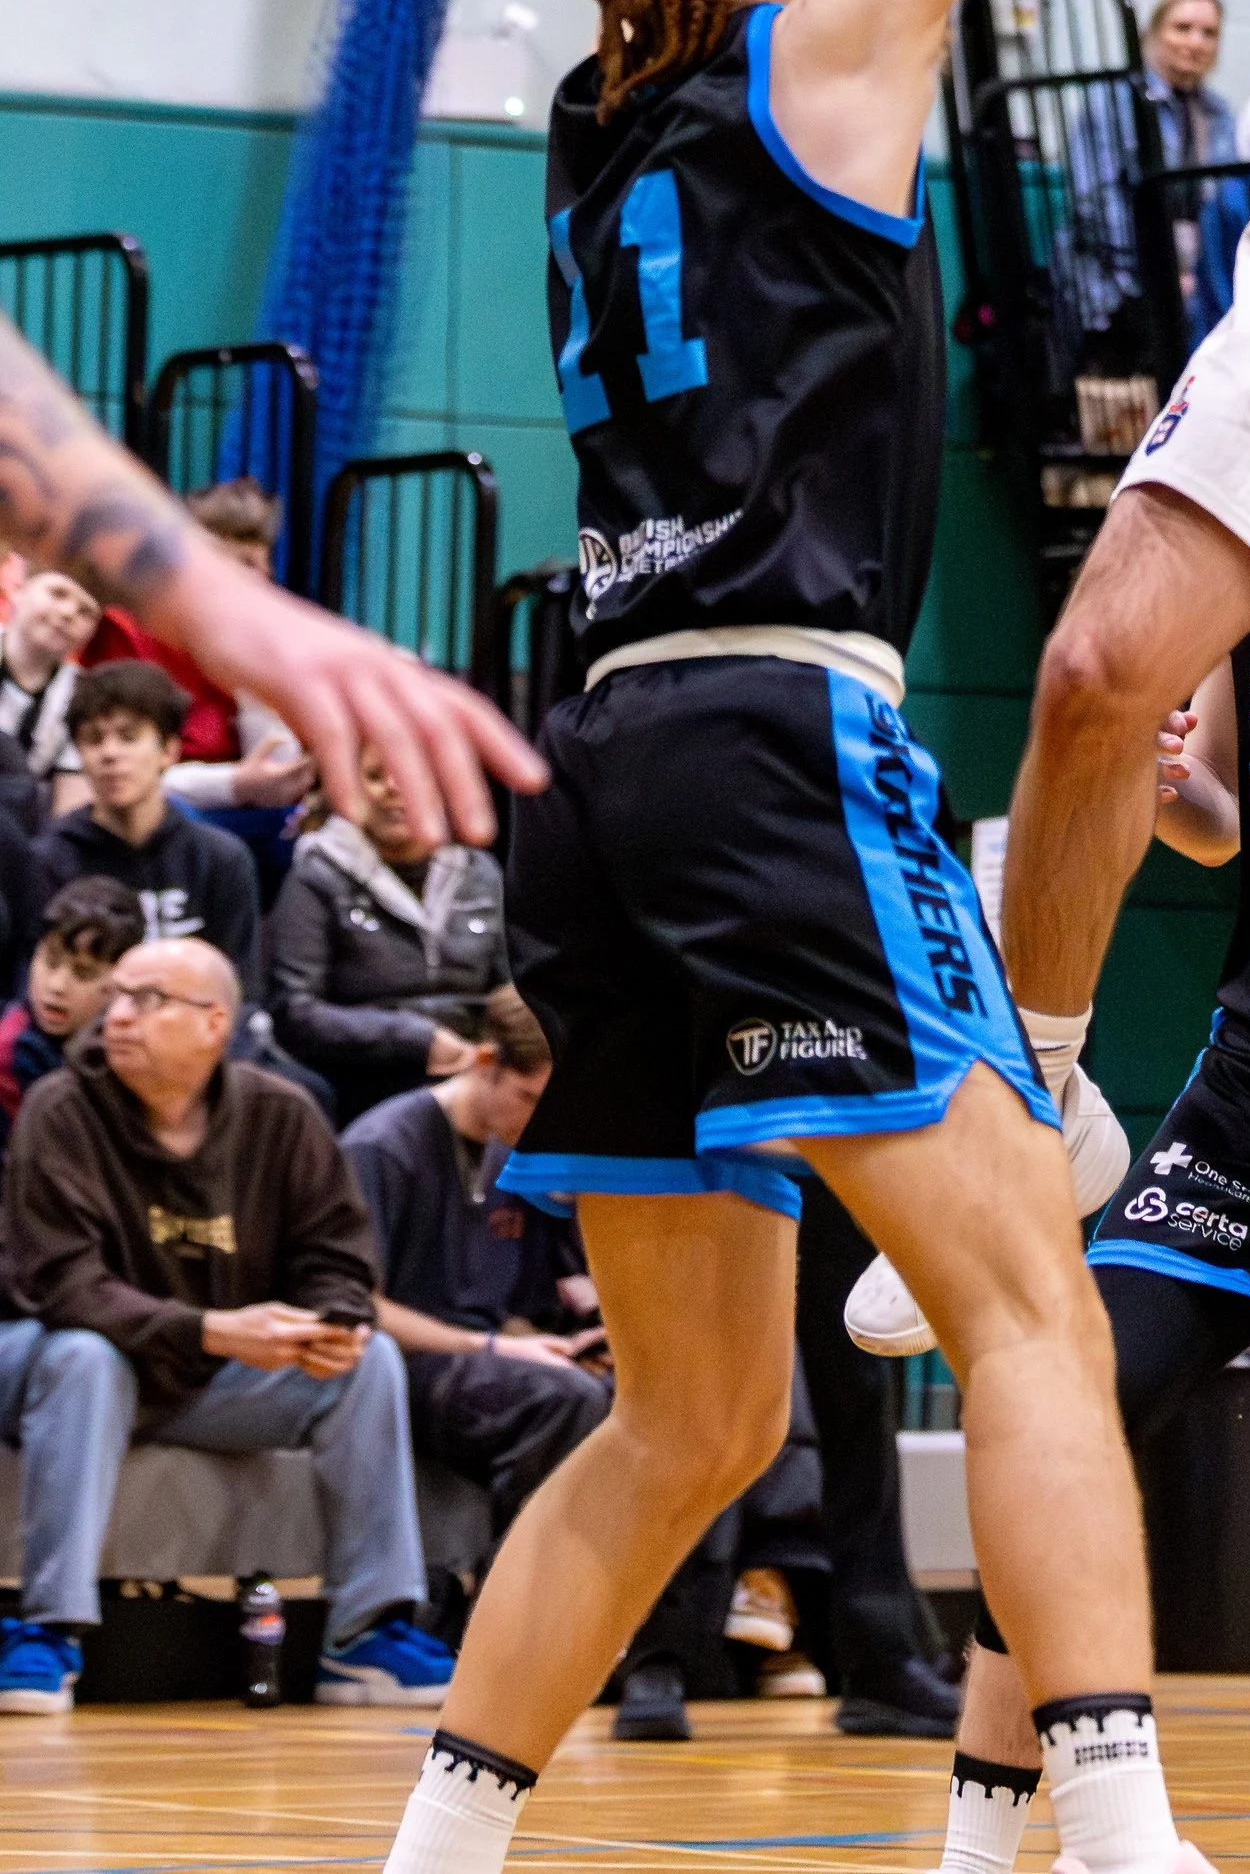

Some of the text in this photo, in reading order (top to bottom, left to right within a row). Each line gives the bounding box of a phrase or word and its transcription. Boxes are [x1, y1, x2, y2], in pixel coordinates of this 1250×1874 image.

[781, 1021, 818, 1043] TAX
[1194, 1160, 1228, 1187] One
[1167, 1213, 1243, 1252] service
[1175, 1200, 1249, 1240] certa
